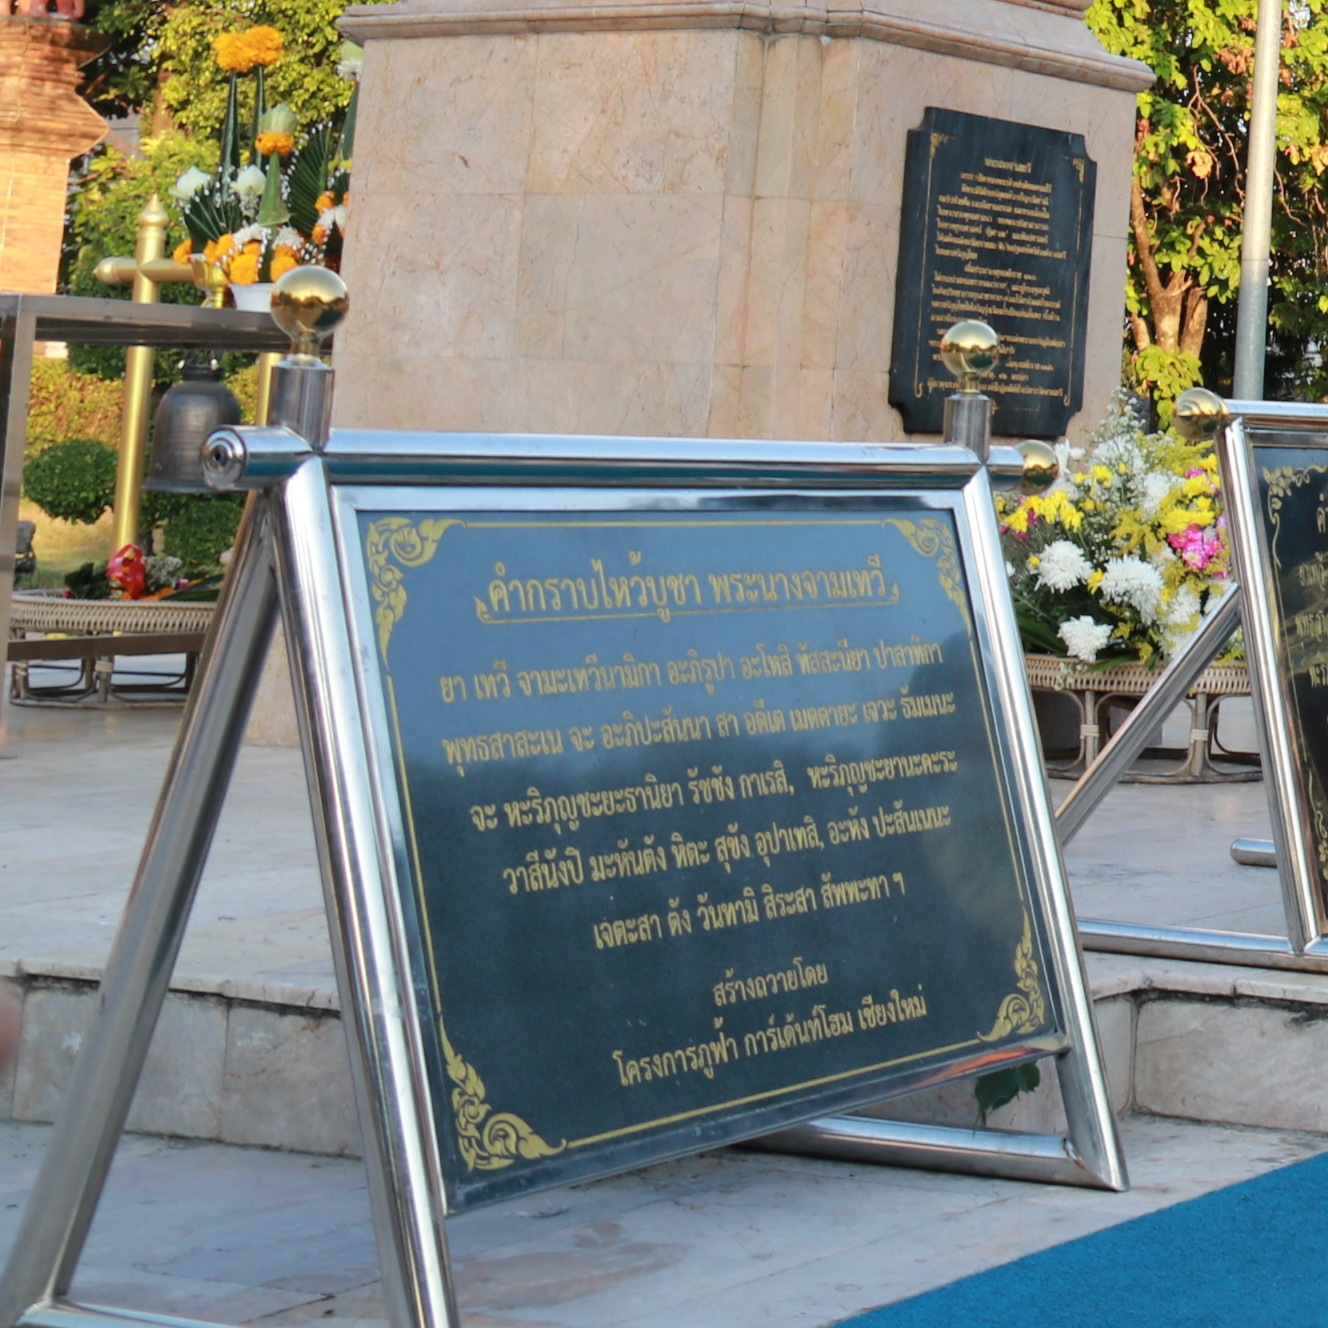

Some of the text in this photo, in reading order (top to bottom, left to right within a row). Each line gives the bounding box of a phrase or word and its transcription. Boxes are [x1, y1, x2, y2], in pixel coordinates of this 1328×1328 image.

[487, 550, 888, 622] คำกราบไหว้บูชา พระนางจามเทวี
[439, 676, 467, 703] ยา
[474, 660, 511, 699] เทวี
[517, 653, 660, 696] จามะเทวีนามิกา
[667, 649, 735, 693] อะภิรูปา
[740, 643, 793, 679] อะโหสิ
[874, 635, 942, 668] ปาสาทิกา
[442, 731, 563, 776] พุทธสาสะเน
[569, 727, 595, 751] จะ
[601, 708, 711, 748] อะภิปะสันนา
[717, 714, 739, 736] สา
[863, 700, 896, 721] เจวะ
[901, 688, 956, 718] ธัมเมนะ
[471, 806, 498, 830] จะ
[504, 774, 682, 831] หะริภุญชะยะธานิยา
[688, 766, 736, 802] รัชชัง
[807, 752, 958, 792] หะริภุญชะยานะคะระ
[503, 848, 583, 893] วาสีนังปิ
[590, 837, 667, 880] มะหันตัง
[672, 833, 709, 867] หิตะ
[715, 825, 750, 872] สุขัง
[829, 809, 870, 844] อะหัง
[873, 802, 950, 836] ปะสันเนนะ
[594, 915, 661, 949] เจตะสา
[669, 899, 692, 934] ตัง
[698, 888, 759, 929] วันทามิ
[763, 885, 816, 918] สิระสา
[822, 875, 889, 907] สัพพะทา
[714, 957, 827, 1005] สร้างถวายโดย
[612, 985, 928, 1085] โครงการภูฟ้า การ์เด้นท์โฮม เชียงใหม่
